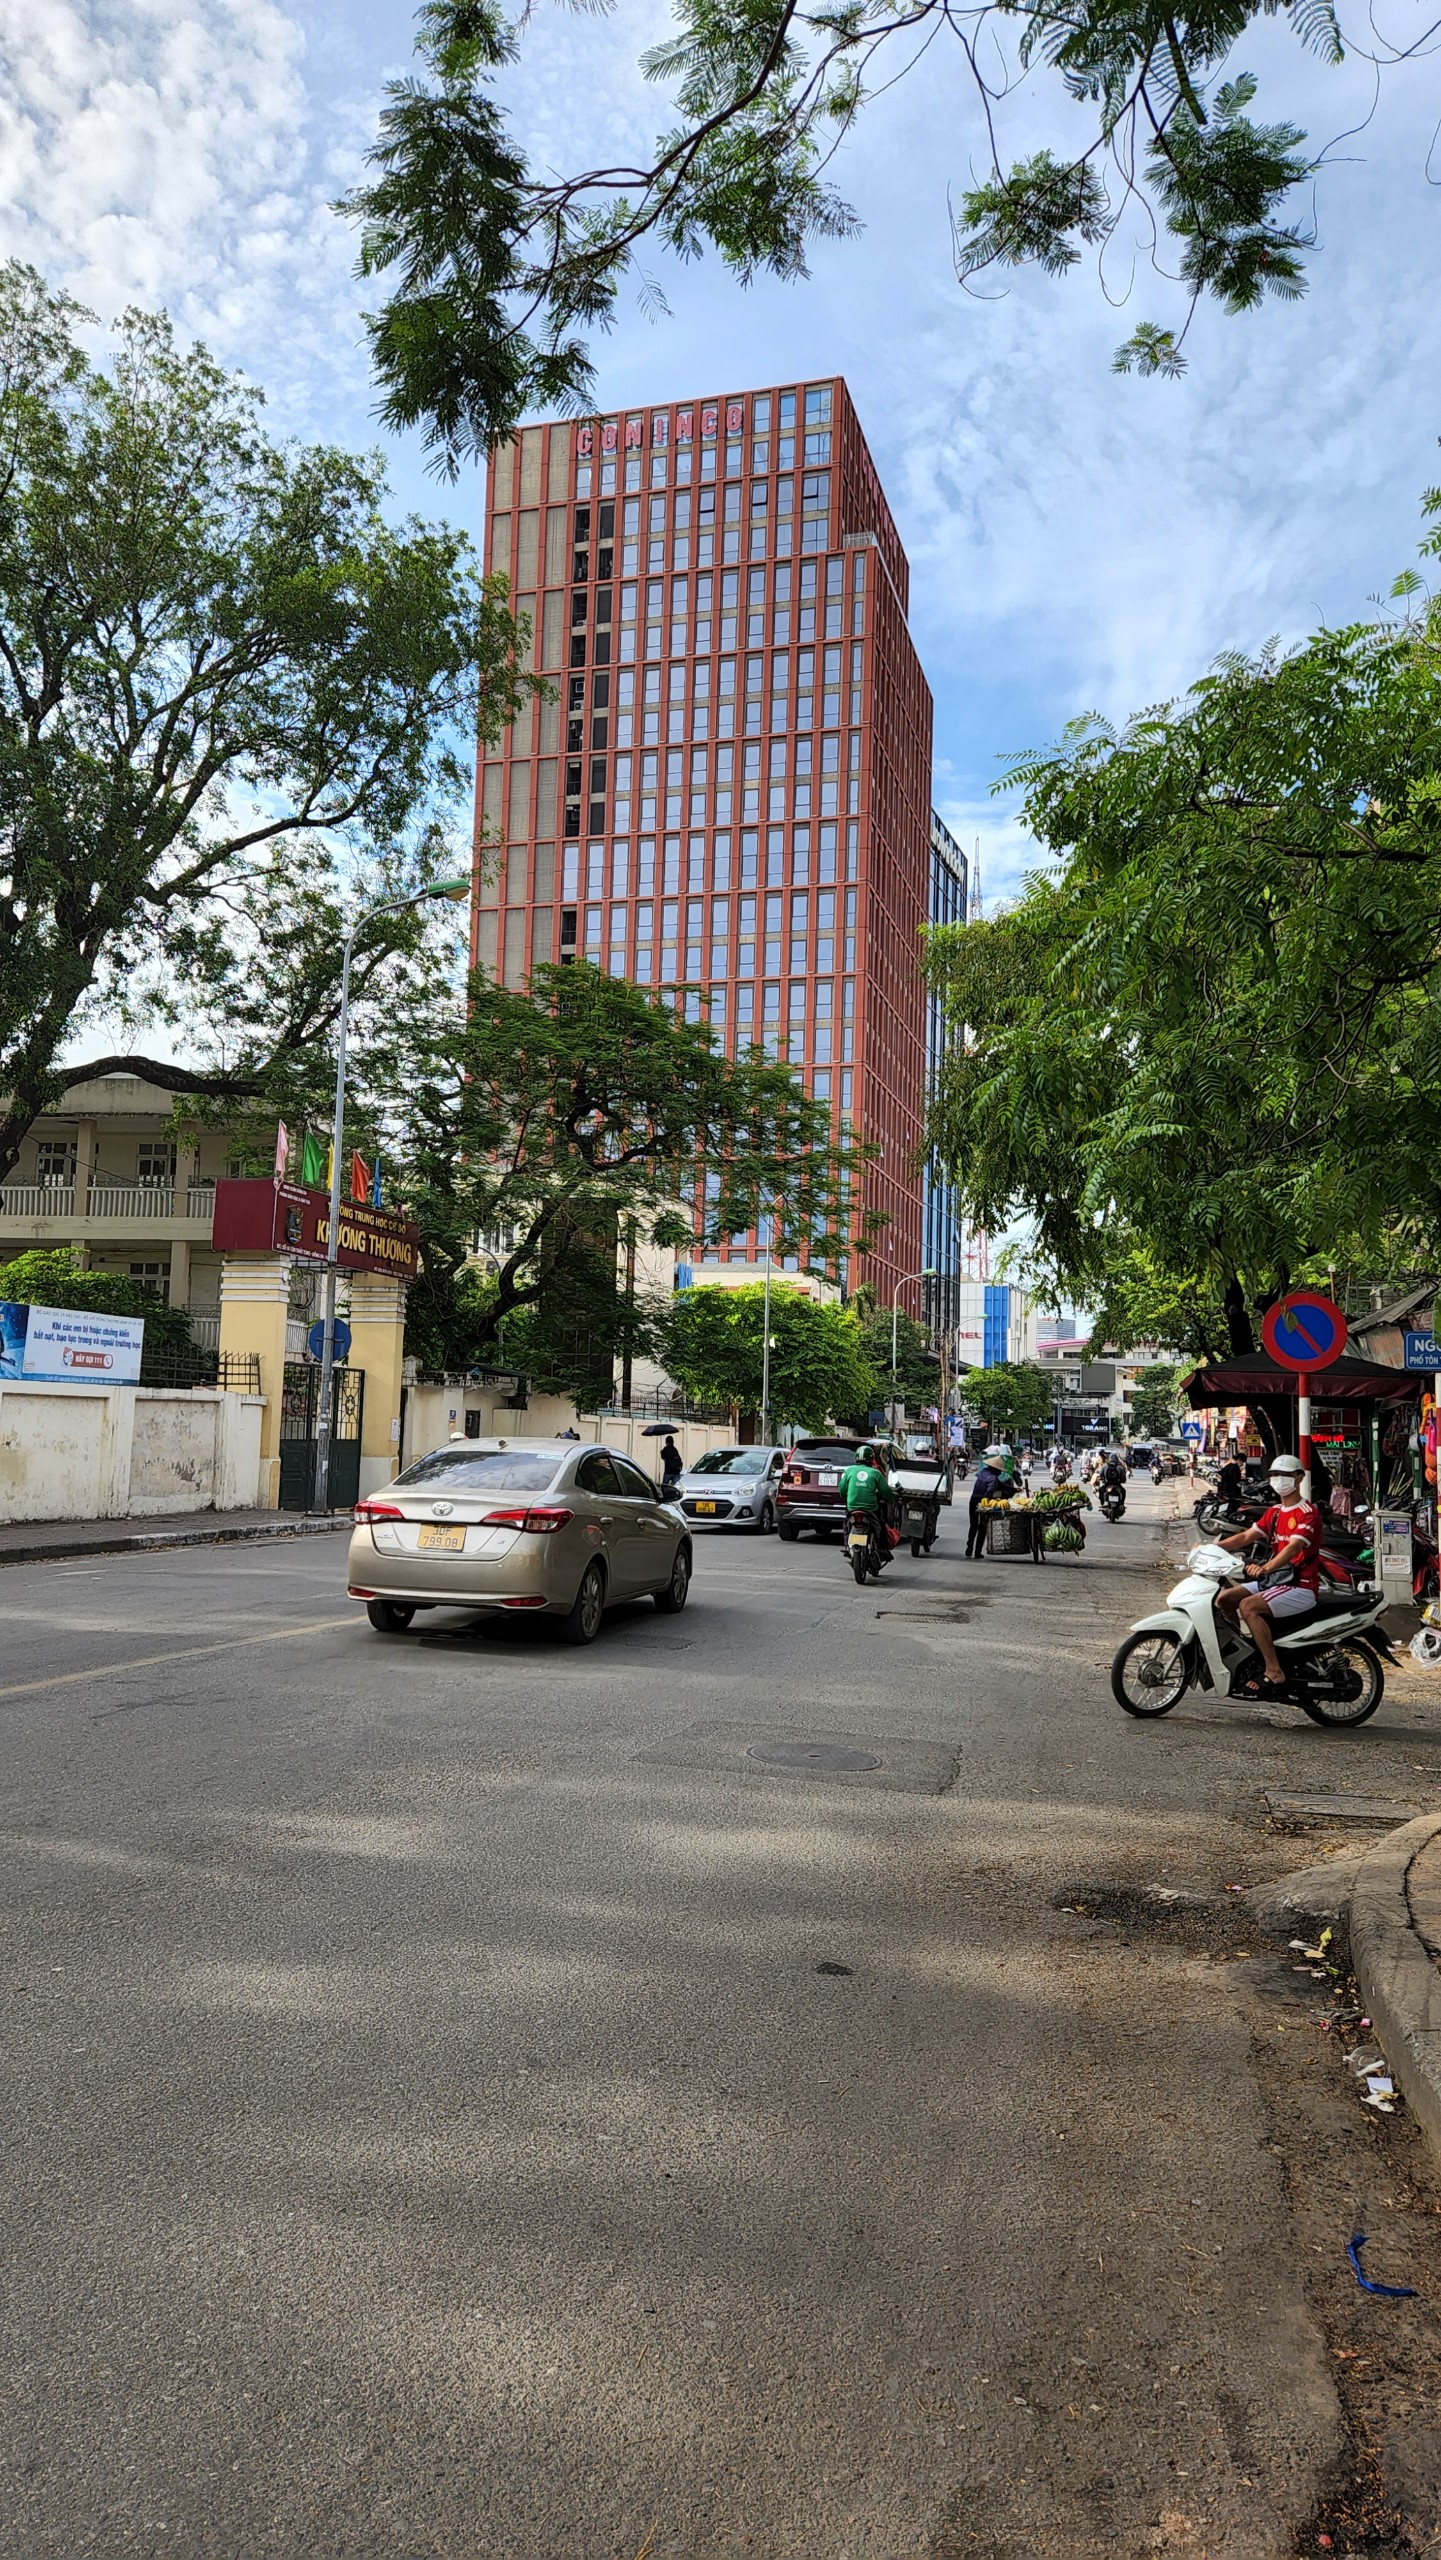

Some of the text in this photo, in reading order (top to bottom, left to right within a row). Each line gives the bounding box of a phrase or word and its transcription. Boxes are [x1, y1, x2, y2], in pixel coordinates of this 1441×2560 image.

[577, 406, 743, 454] CONINCO
[327, 1201, 354, 1219] TỜNG
[354, 1210, 375, 1225] TRUNG
[375, 1216, 388, 1231] HỌC
[369, 1233, 412, 1266] THƯỢNG
[52, 1321, 61, 1330] Khi
[63, 1323, 72, 1331] các
[83, 1324, 88, 1335] bị
[89, 1325, 102, 1336] hoặc
[103, 1327, 118, 1338] chứng
[119, 1328, 130, 1337] kiến
[34, 1328, 44, 1339] bắt
[56, 1333, 67, 1343] bạo
[68, 1334, 77, 1344] lực
[78, 1335, 92, 1346] trong
[93, 1337, 99, 1345] và
[100, 1338, 114, 1347] ngoài
[115, 1339, 131, 1350] trường
[132, 1341, 142, 1350] học
[85, 1355, 94, 1366] GỌI
[94, 1356, 103, 1364] 111
[1410, 1353, 1439, 1365] PHỐ TÔN
[432, 1525, 453, 1536] 30F
[423, 1536, 458, 1548] 799.08
